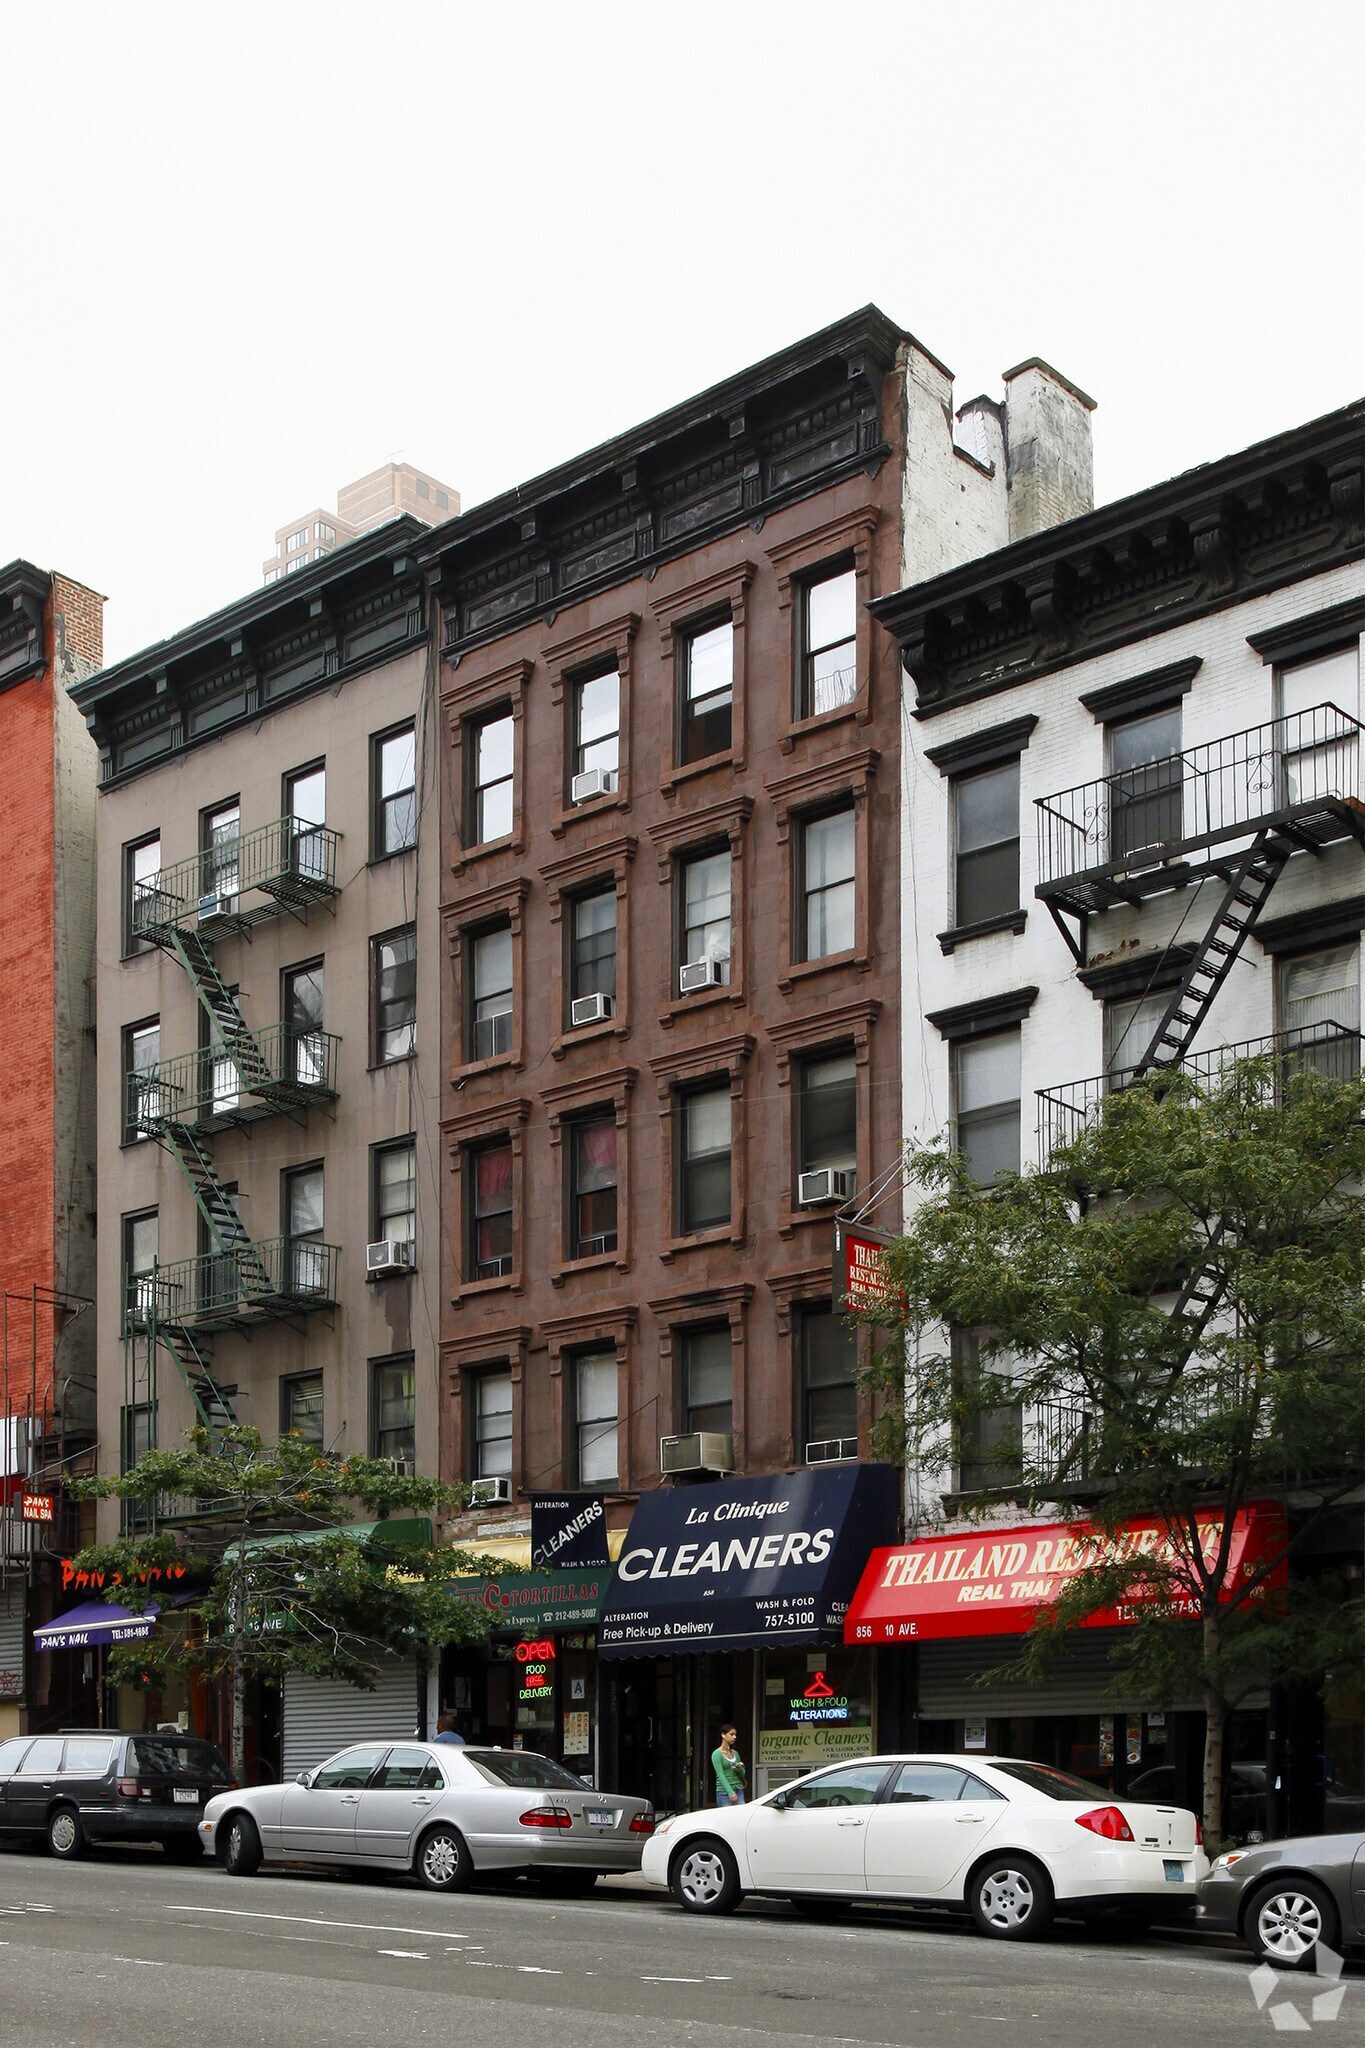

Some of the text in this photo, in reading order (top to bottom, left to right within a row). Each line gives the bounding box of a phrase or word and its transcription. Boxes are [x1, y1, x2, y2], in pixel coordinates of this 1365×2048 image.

[24, 1496, 49, 1508] PAN'S
[24, 1507, 52, 1520] NAIL SPA
[685, 1500, 790, 1525] La Clinique
[533, 1500, 603, 1565] CLEANERS
[618, 1528, 834, 1582] CLEANERS
[880, 1543, 1028, 1588] THAILAND
[957, 1584, 1005, 1603] REAL
[1009, 1579, 1053, 1599] THAI
[756, 1597, 815, 1610] WASH & FOLD
[831, 1602, 850, 1612] CLEA
[603, 1611, 649, 1622] ALTERATION
[765, 1612, 815, 1627] 757-5100
[603, 1622, 714, 1640] Free Pick-up & Delivery
[856, 1623, 919, 1638] 856 10 AVE.
[41, 1635, 65, 1649] PAN'S
[69, 1632, 89, 1645] NAIL
[516, 1641, 555, 1661] OPEN
[525, 1664, 546, 1675] FOOD
[519, 1686, 553, 1700] DELIVERY
[574, 1681, 583, 1694] A
[790, 1696, 848, 1709] WASH & FOLD
[790, 1708, 848, 1720] ALTERATIONS
[761, 1730, 871, 1750] organic Cleaners
